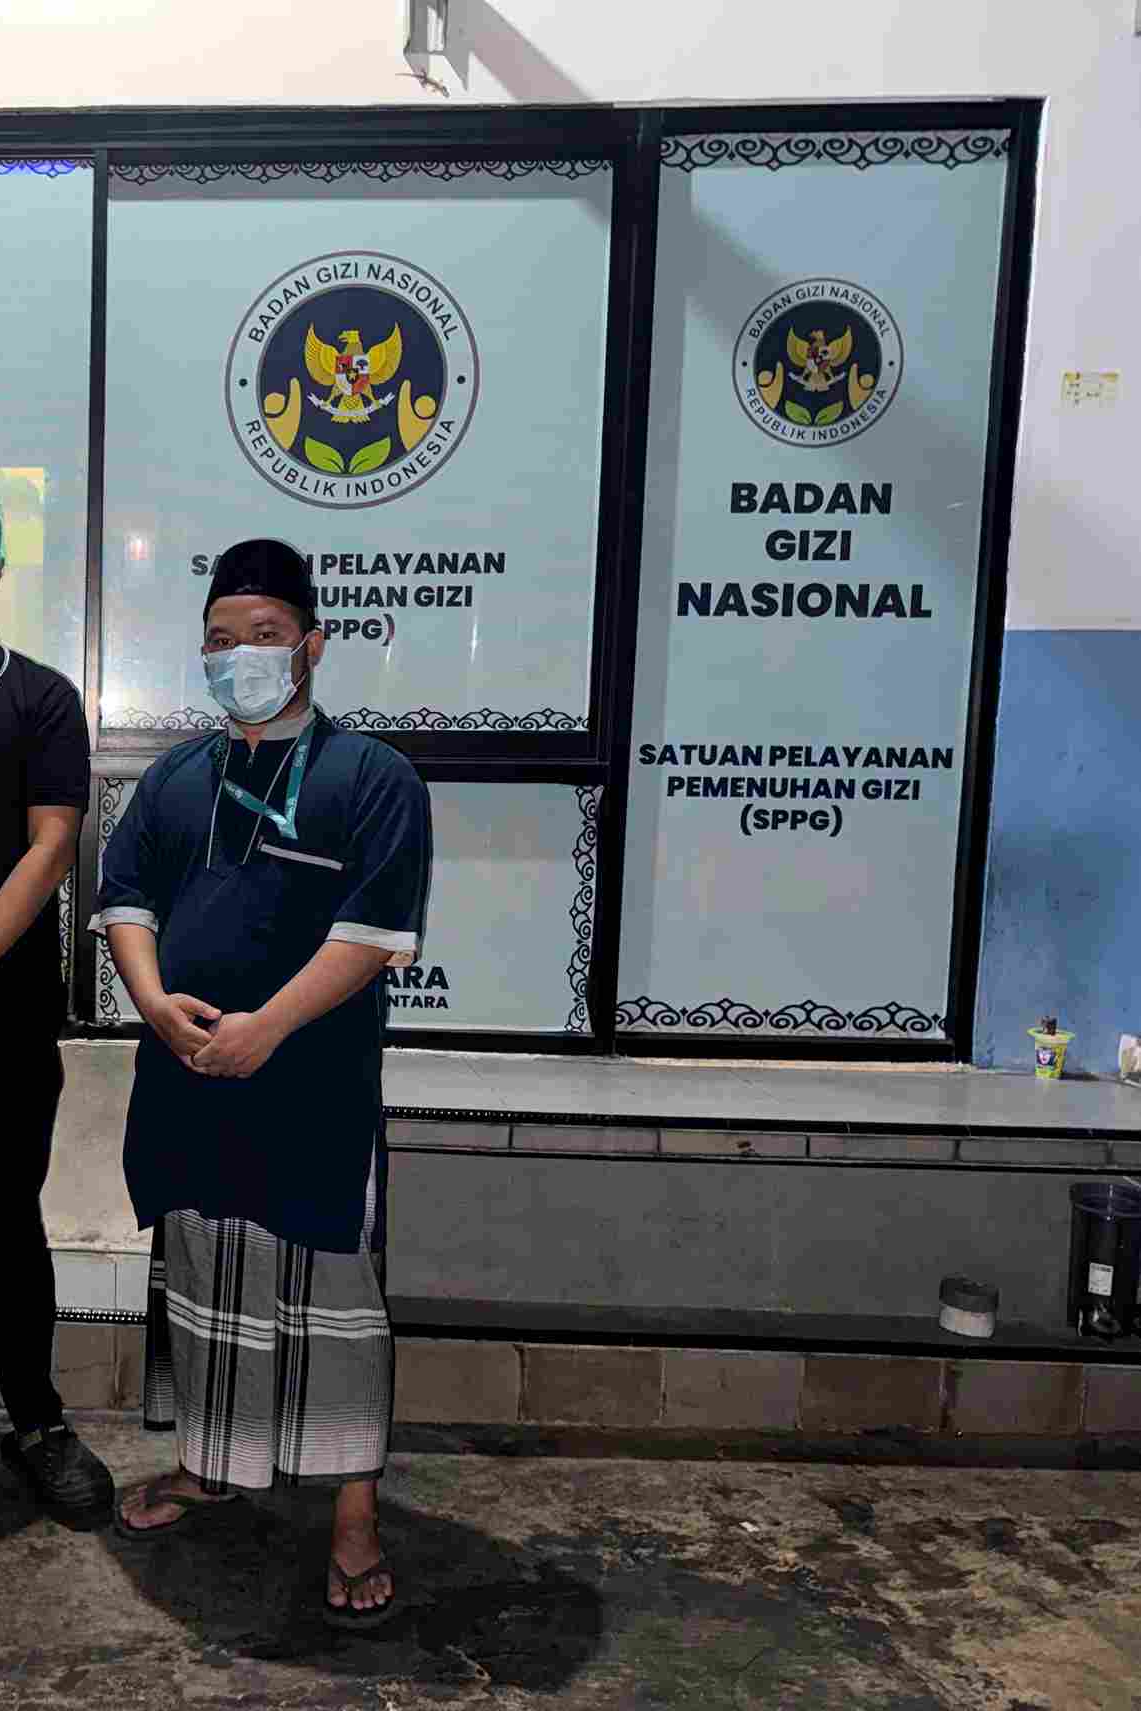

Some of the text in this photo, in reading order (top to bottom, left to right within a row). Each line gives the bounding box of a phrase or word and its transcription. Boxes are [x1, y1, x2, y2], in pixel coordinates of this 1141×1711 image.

[248, 262, 459, 343] BADAN GIZI NASIONAL
[748, 285, 891, 339] BADAN GIZI NASIONAL
[746, 388, 887, 441] REPUBLIK INDONESIA
[246, 418, 455, 498] REPUBLIK INDONESIA
[730, 482, 892, 514] BADAN
[765, 529, 852, 561] GIZI
[320, 553, 505, 576] PELAYANAN
[413, 585, 473, 608] GIZI
[677, 582, 932, 618] NASIONAL
[638, 744, 954, 769] SATUAN PELAYANAN
[666, 776, 921, 800] PEMENUHAN GIZI
[740, 803, 843, 837] (SPPG)
[387, 995, 449, 1009] NTARA
